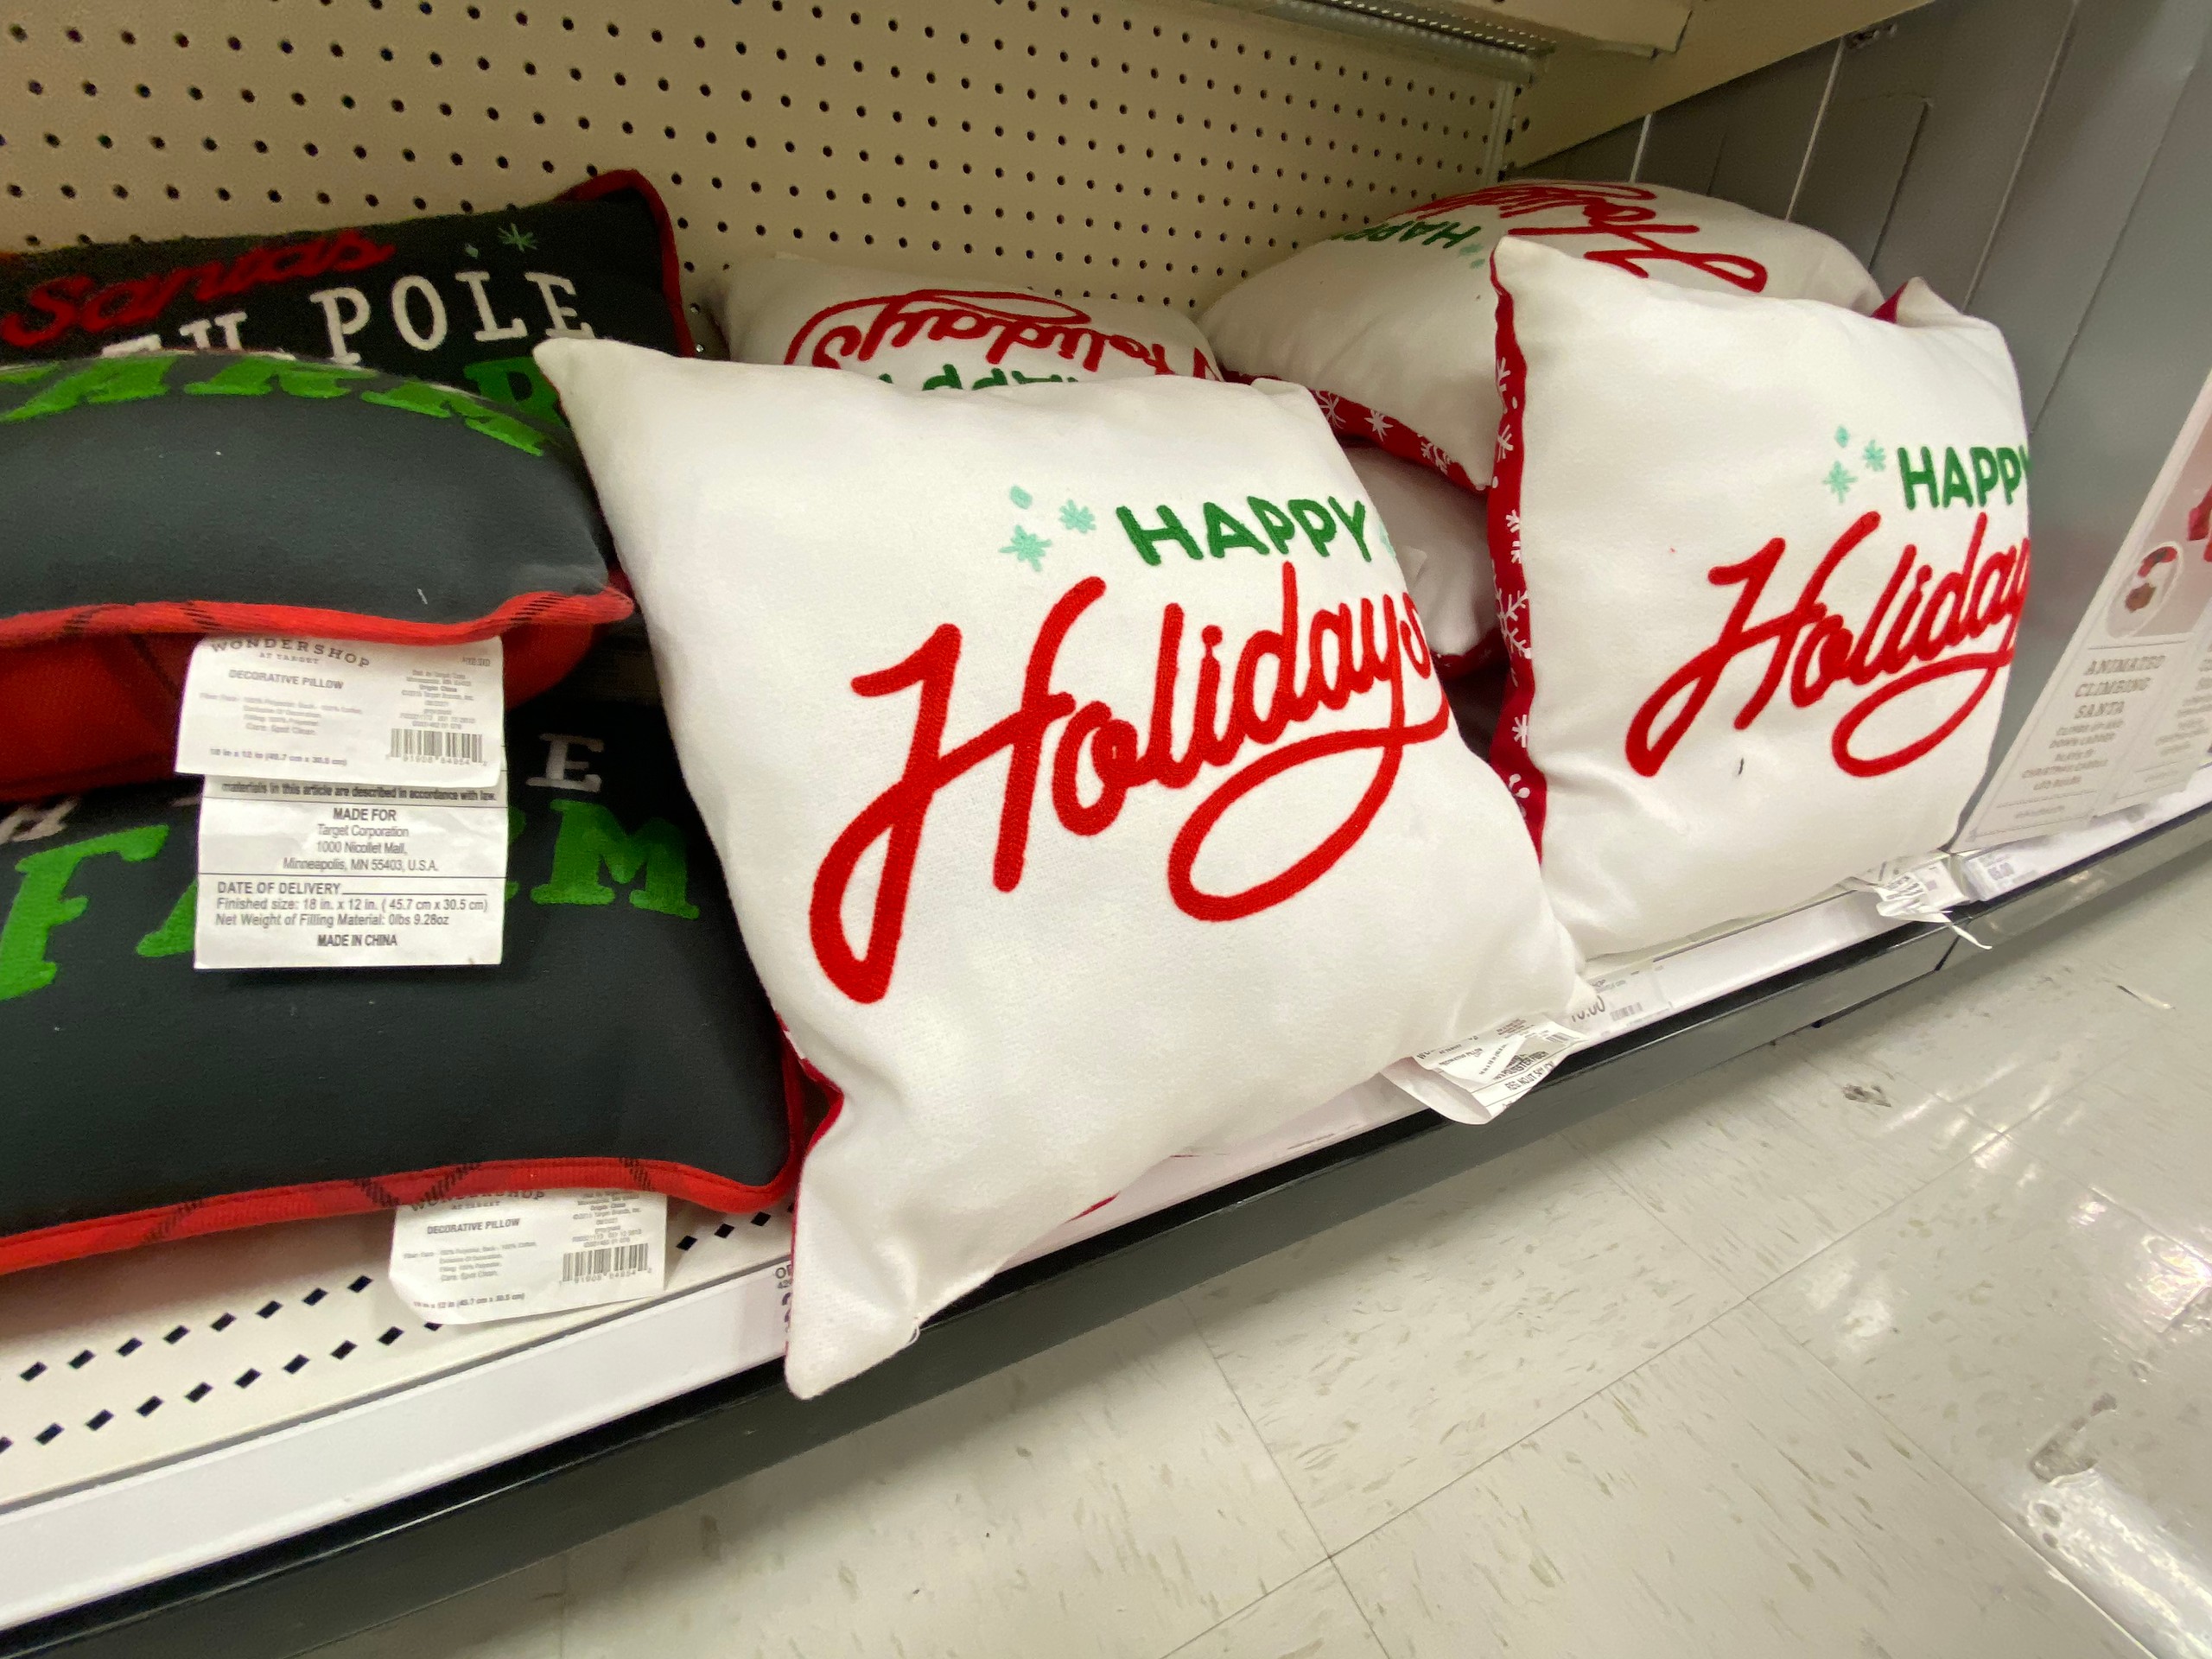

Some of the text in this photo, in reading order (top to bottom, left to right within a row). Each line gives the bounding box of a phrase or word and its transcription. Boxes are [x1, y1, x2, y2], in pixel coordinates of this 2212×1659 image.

[310, 270, 597, 367] POLE
[1115, 494, 1372, 565] HAPPY
[211, 639, 370, 667] WONDERSHOP
[228, 670, 344, 690] DECORATIVE PILLOW
[2075, 701, 2125, 719] SANTA
[333, 808, 397, 821] MADE FOR
[317, 823, 409, 840] Target Corporation
[317, 841, 341, 853] 1000
[345, 842, 381, 854] Nicollet
[283, 857, 347, 872] Minneapolis,
[351, 859, 369, 870] MN
[408, 860, 439, 872] U.S.A.
[217, 881, 252, 893] DATE
[257, 882, 275, 893] OF
[216, 897, 268, 910] Finished
[271, 899, 299, 910] size:
[303, 899, 317, 910] 18
[337, 900, 345, 910] x
[349, 899, 361, 910] 12
[390, 899, 413, 910] 45.7
[416, 900, 431, 911] cm
[434, 901, 440, 911] x
[443, 899, 466, 911] 30.5
[468, 899, 488, 912] cm)
[215, 913, 237, 925] Net
[241, 913, 281, 928] Weight
[284, 913, 296, 925] of
[299, 913, 334, 928] Filling
[337, 914, 385, 925] Material:
[317, 934, 398, 946] MADE IN CHINA
[427, 1217, 520, 1235] DECORATIVE PILLOW
